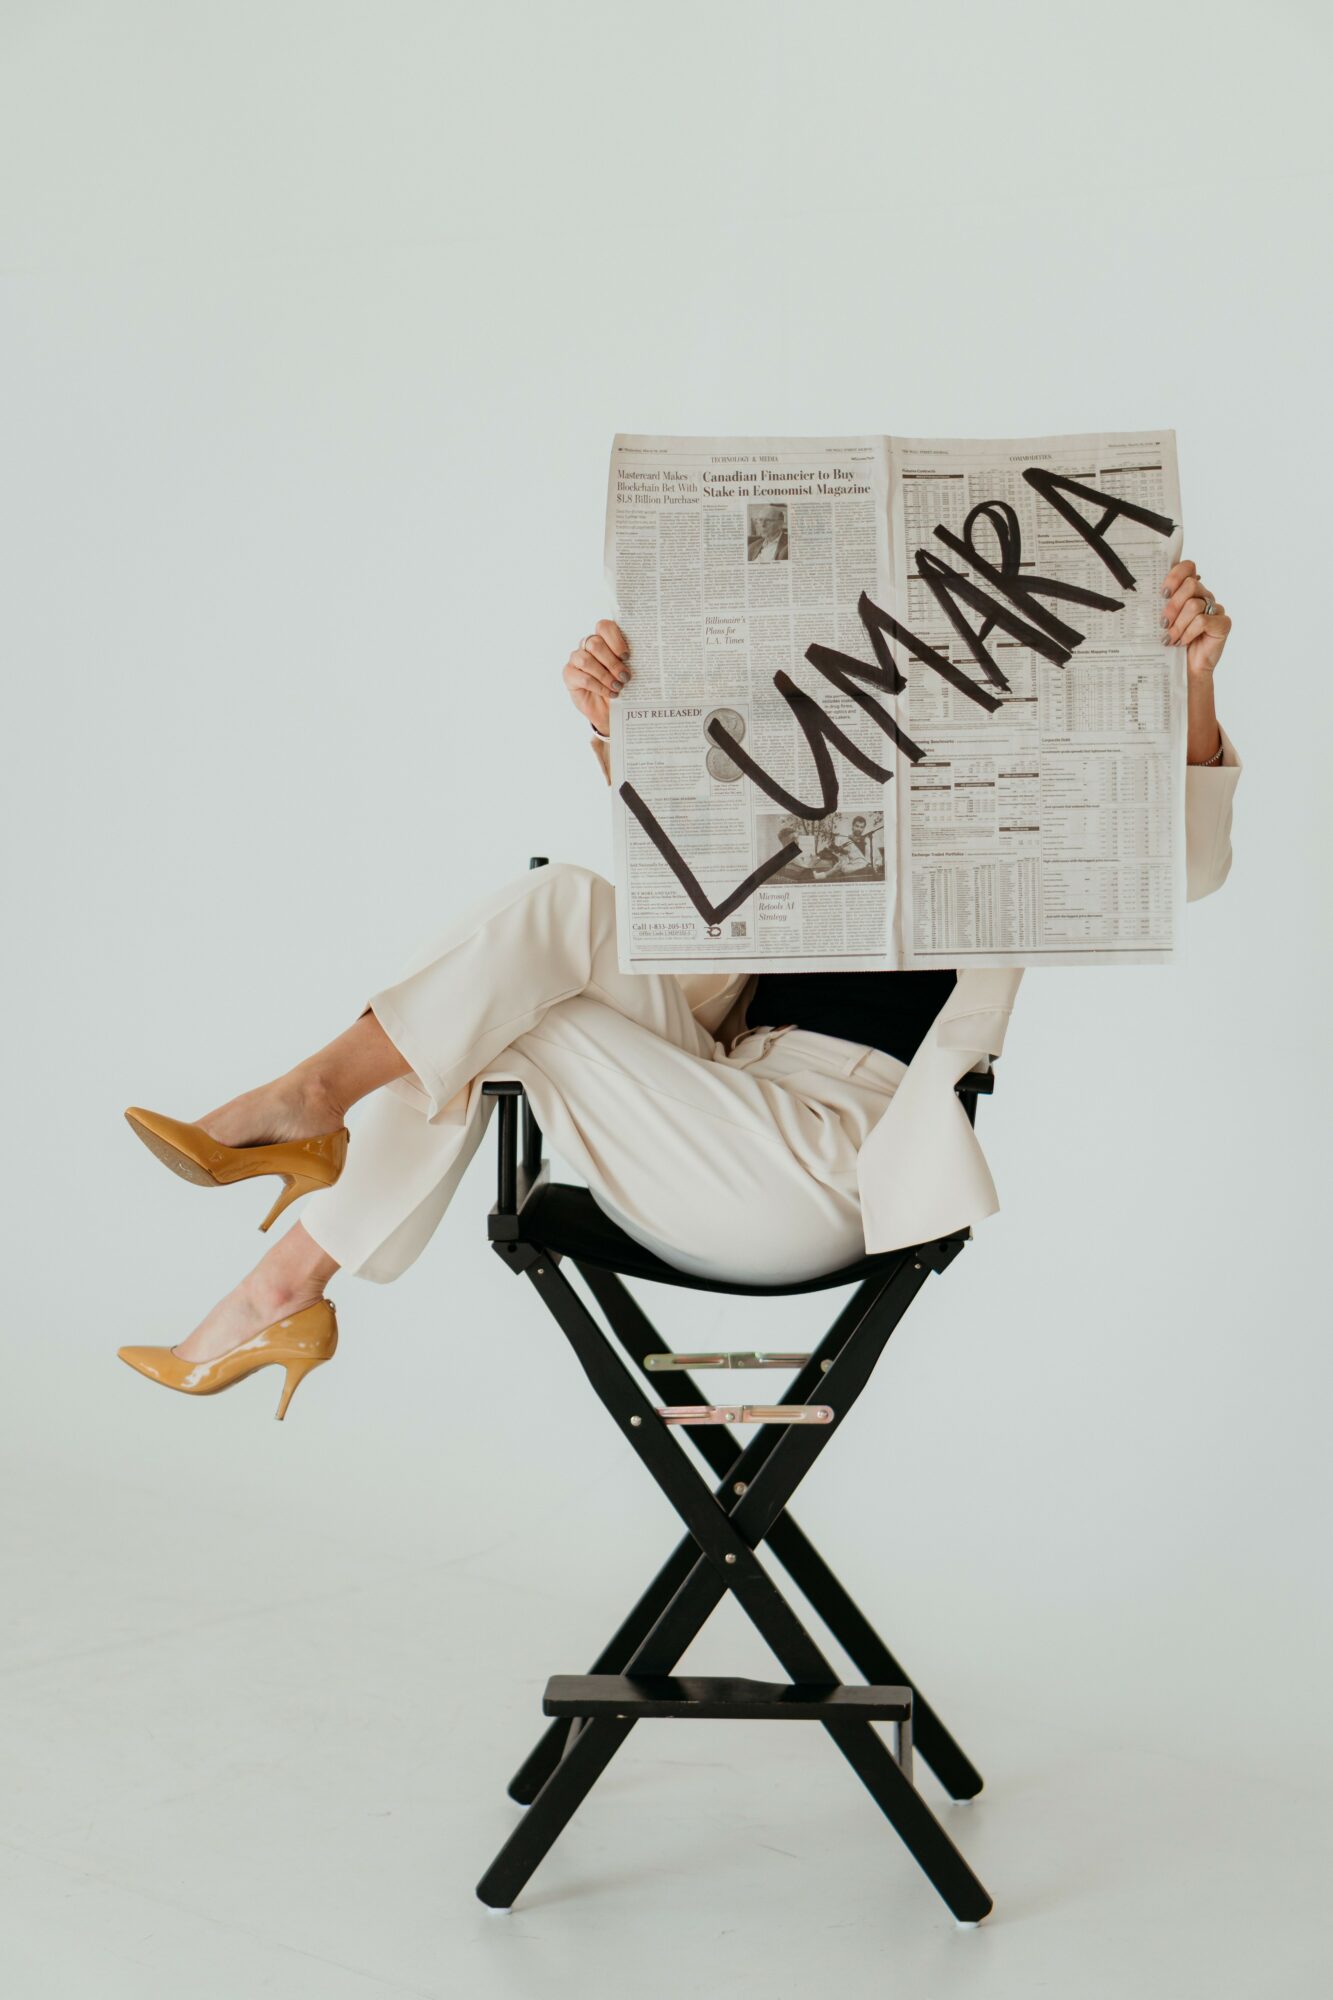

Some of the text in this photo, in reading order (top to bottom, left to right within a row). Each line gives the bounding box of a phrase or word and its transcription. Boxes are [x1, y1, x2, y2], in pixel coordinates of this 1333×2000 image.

[710, 456, 750, 464] TECHNOLOGY
[759, 455, 779, 463] MEDIA
[1009, 454, 1052, 463] COMMODITIES
[617, 469, 688, 481] Mastercard Makes
[702, 468, 855, 483] Canadian Financier to Buy
[617, 481, 698, 493] Blockchain Bet With
[703, 483, 871, 498] Stake in Economist Magazine
[616, 494, 700, 505] $1.8 Billion Purchase
[705, 615, 746, 625] Billionaire's
[705, 626, 736, 636] Plans for
[706, 636, 745, 645] L.A. Times
[619, 467, 1178, 927] LUMARA
[625, 708, 702, 720] JUST RELEASED!
[758, 892, 790, 901] Microsoft
[758, 902, 784, 911] Retools
[758, 913, 787, 922] Strategy
[632, 922, 647, 930] Call
